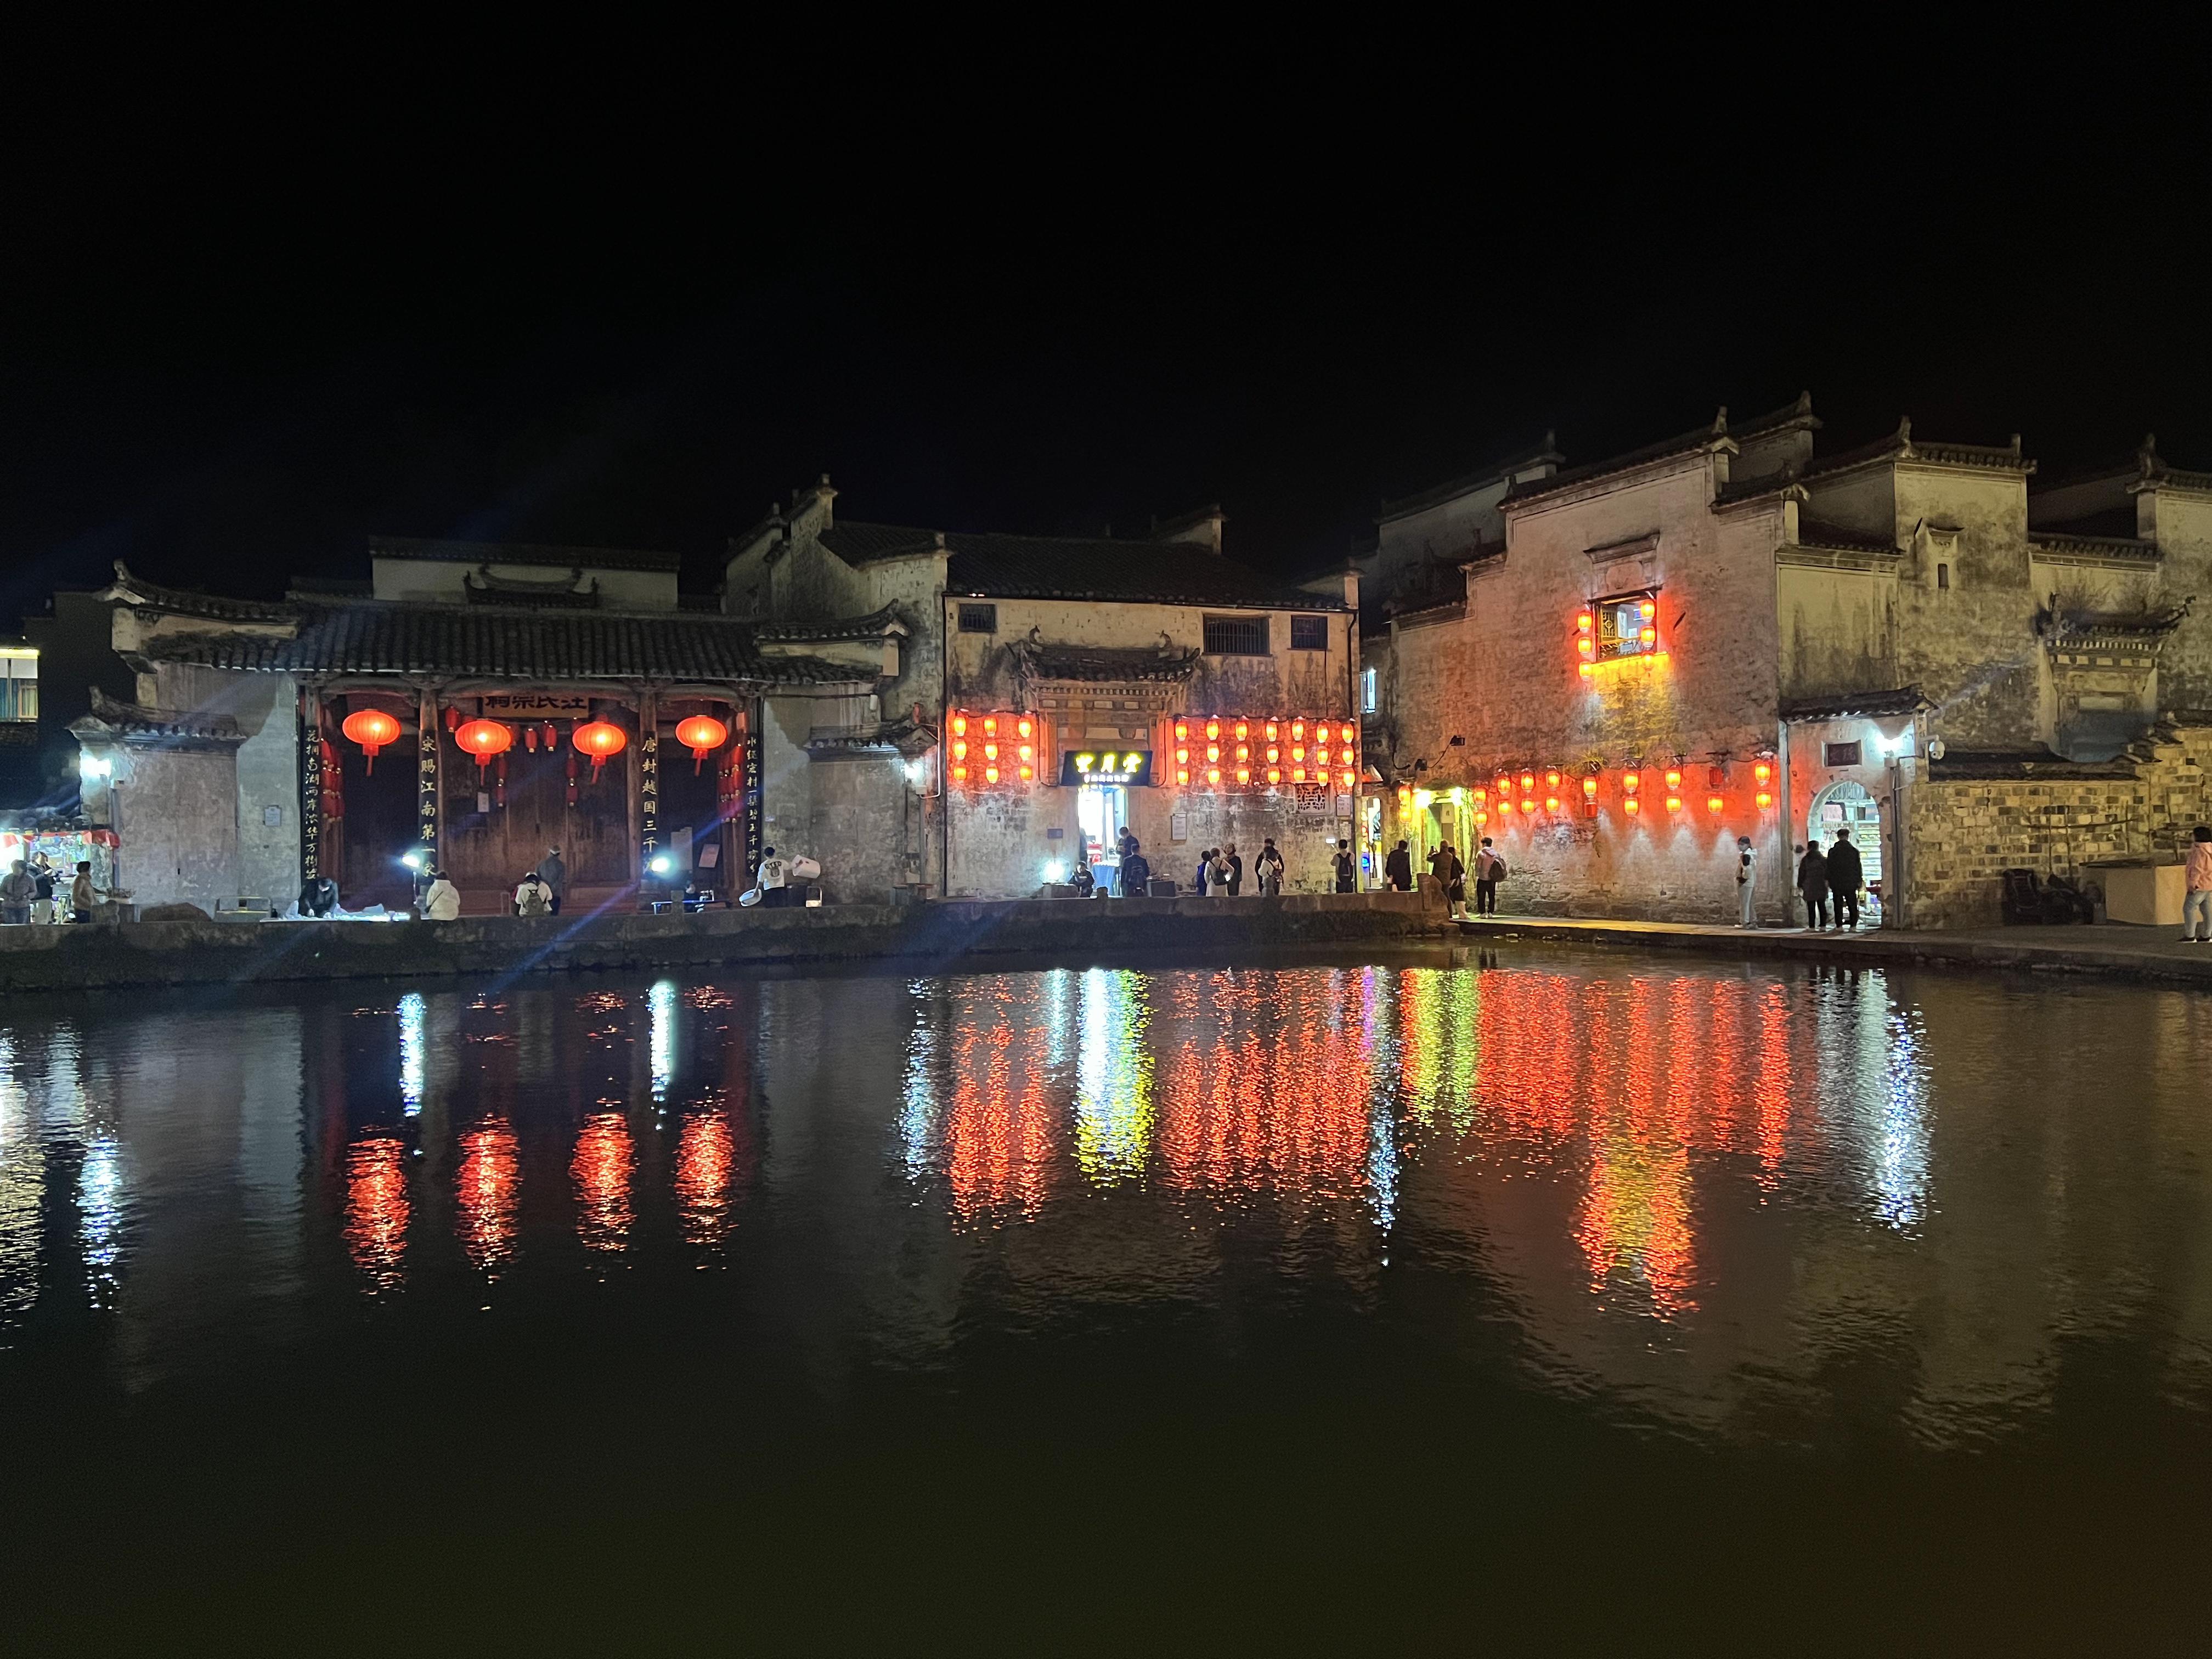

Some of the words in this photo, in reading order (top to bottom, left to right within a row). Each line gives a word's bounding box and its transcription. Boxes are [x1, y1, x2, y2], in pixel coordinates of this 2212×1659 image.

[420, 736, 437, 878] 宋赐江南第一家
[641, 737, 659, 875] 唐封越国三千
